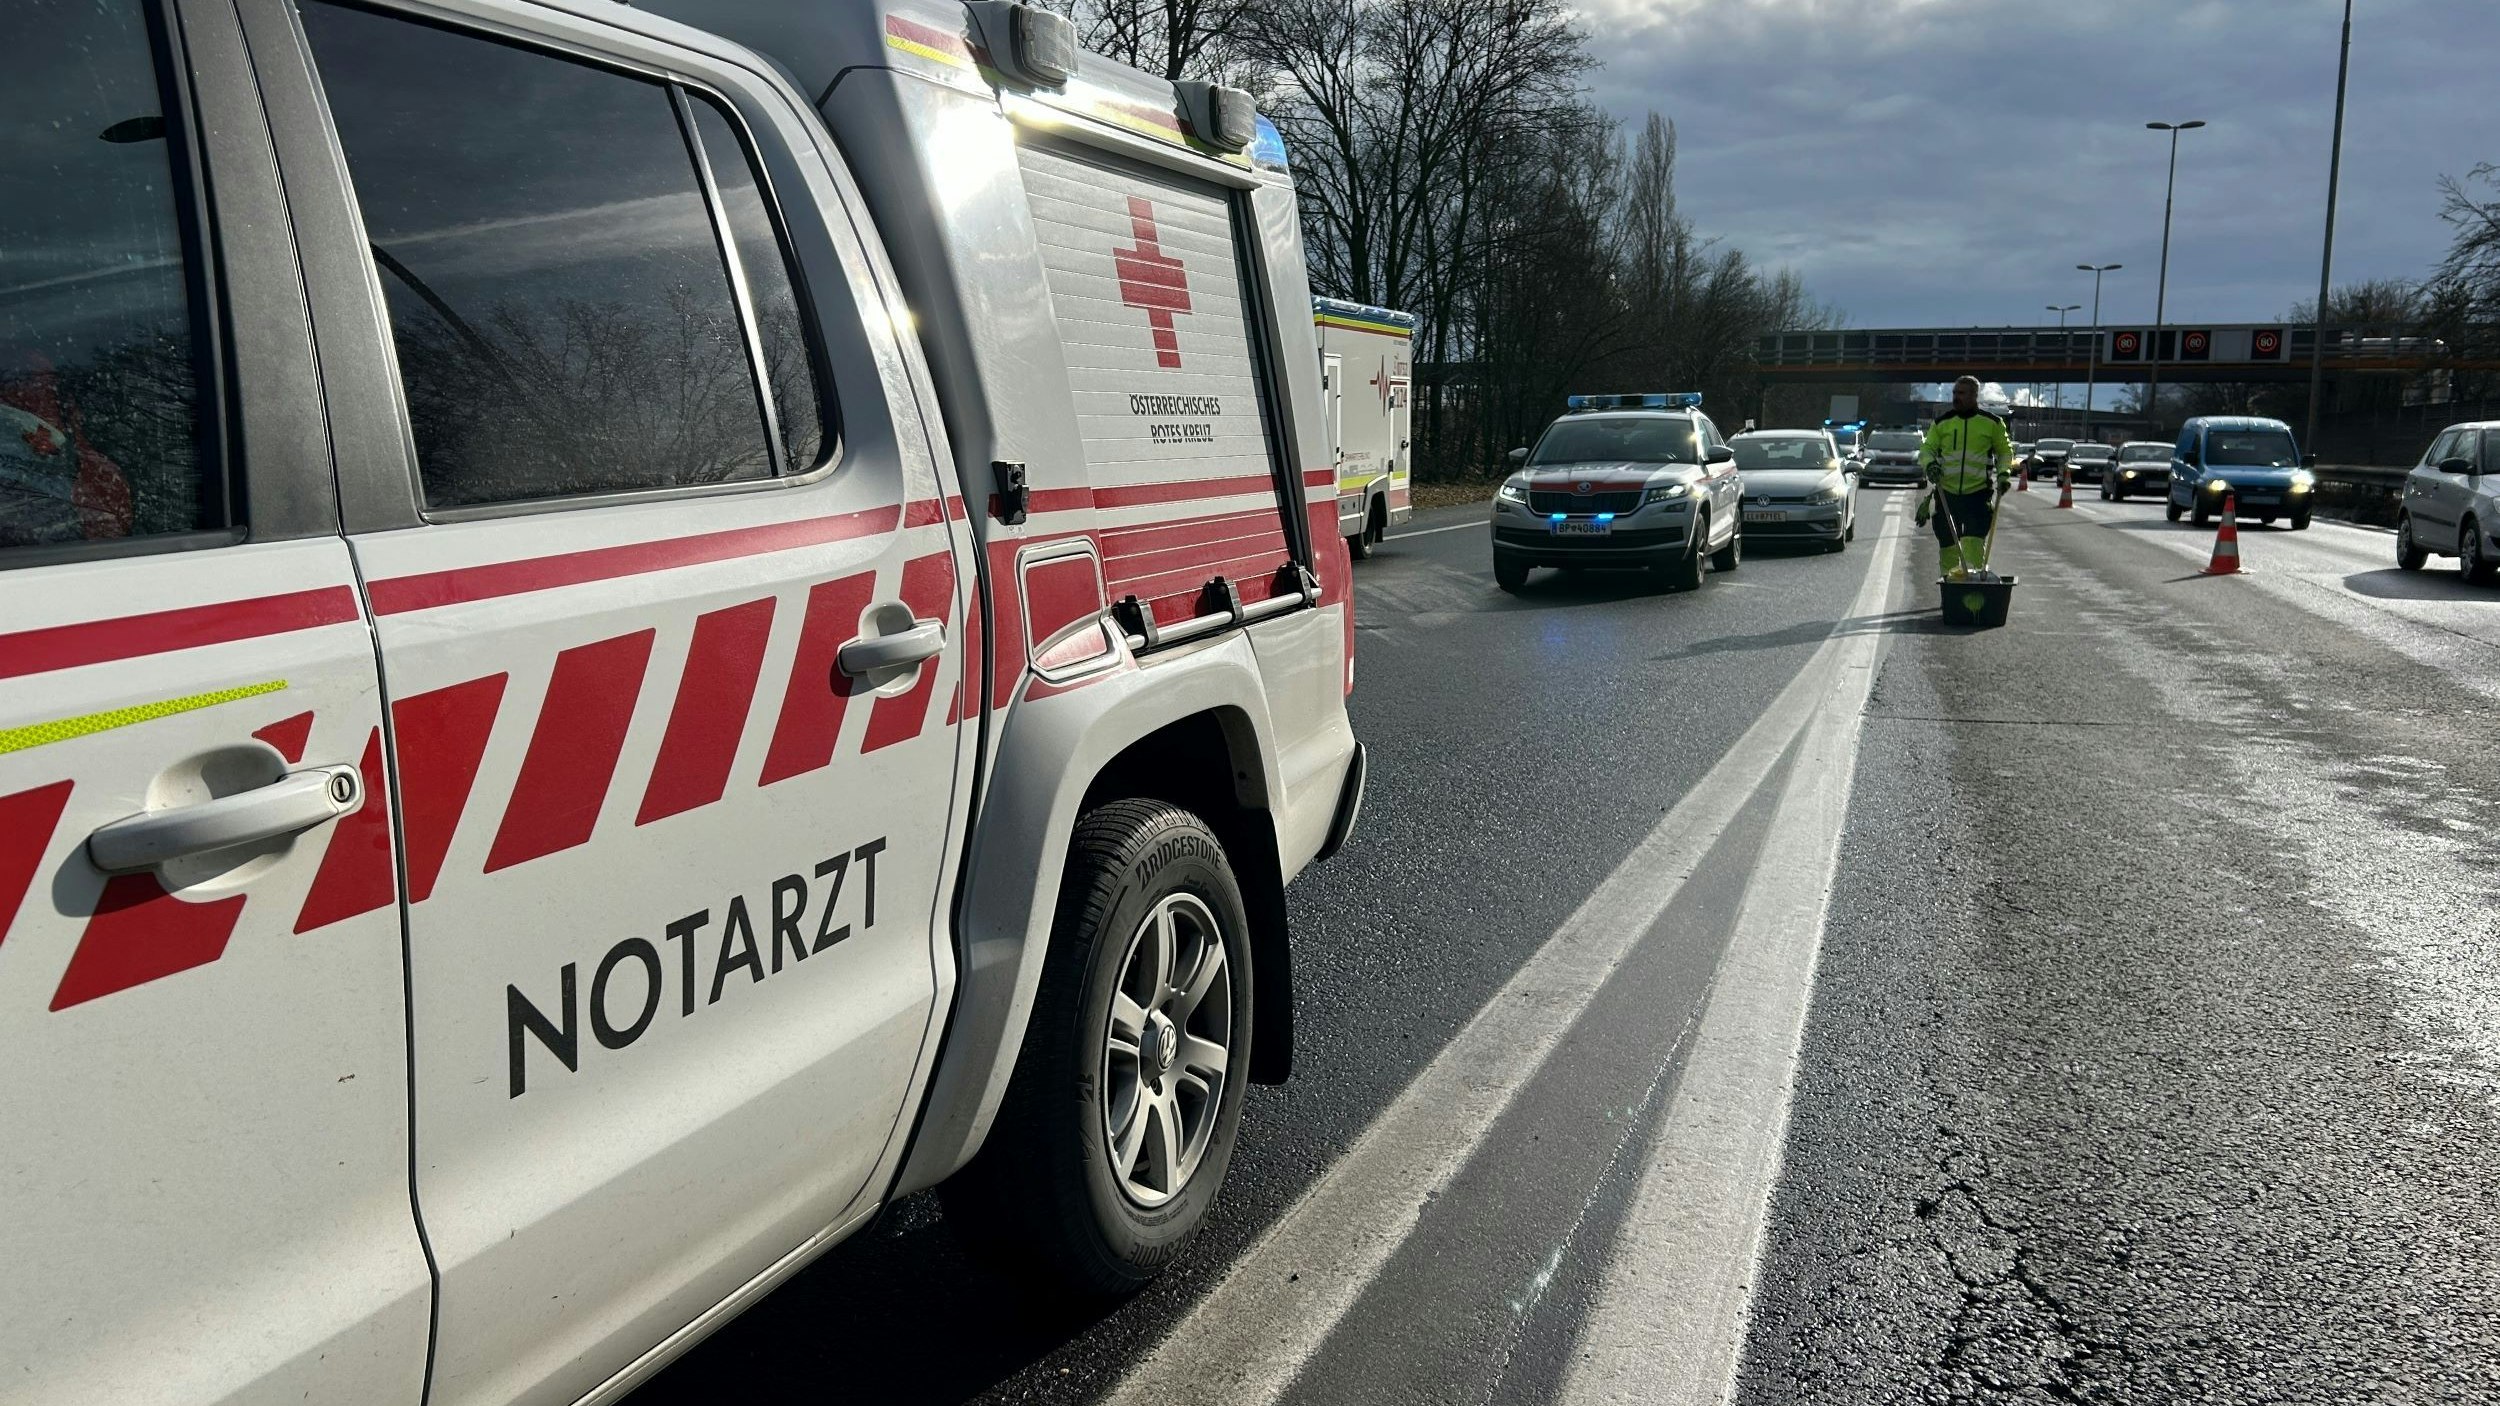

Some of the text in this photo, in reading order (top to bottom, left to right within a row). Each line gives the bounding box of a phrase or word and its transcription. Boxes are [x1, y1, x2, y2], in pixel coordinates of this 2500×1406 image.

[2120, 338, 2132, 347] 80
[2190, 337, 2202, 347] 80
[2260, 337, 2272, 346] 80
[1129, 394, 1221, 415] ÖSTERREICHISCHES
[1151, 424, 1214, 444] ROTES KREUZ
[1136, 836, 1221, 893] BRIDGESTONE
[507, 836, 886, 1099] NOTARZT
